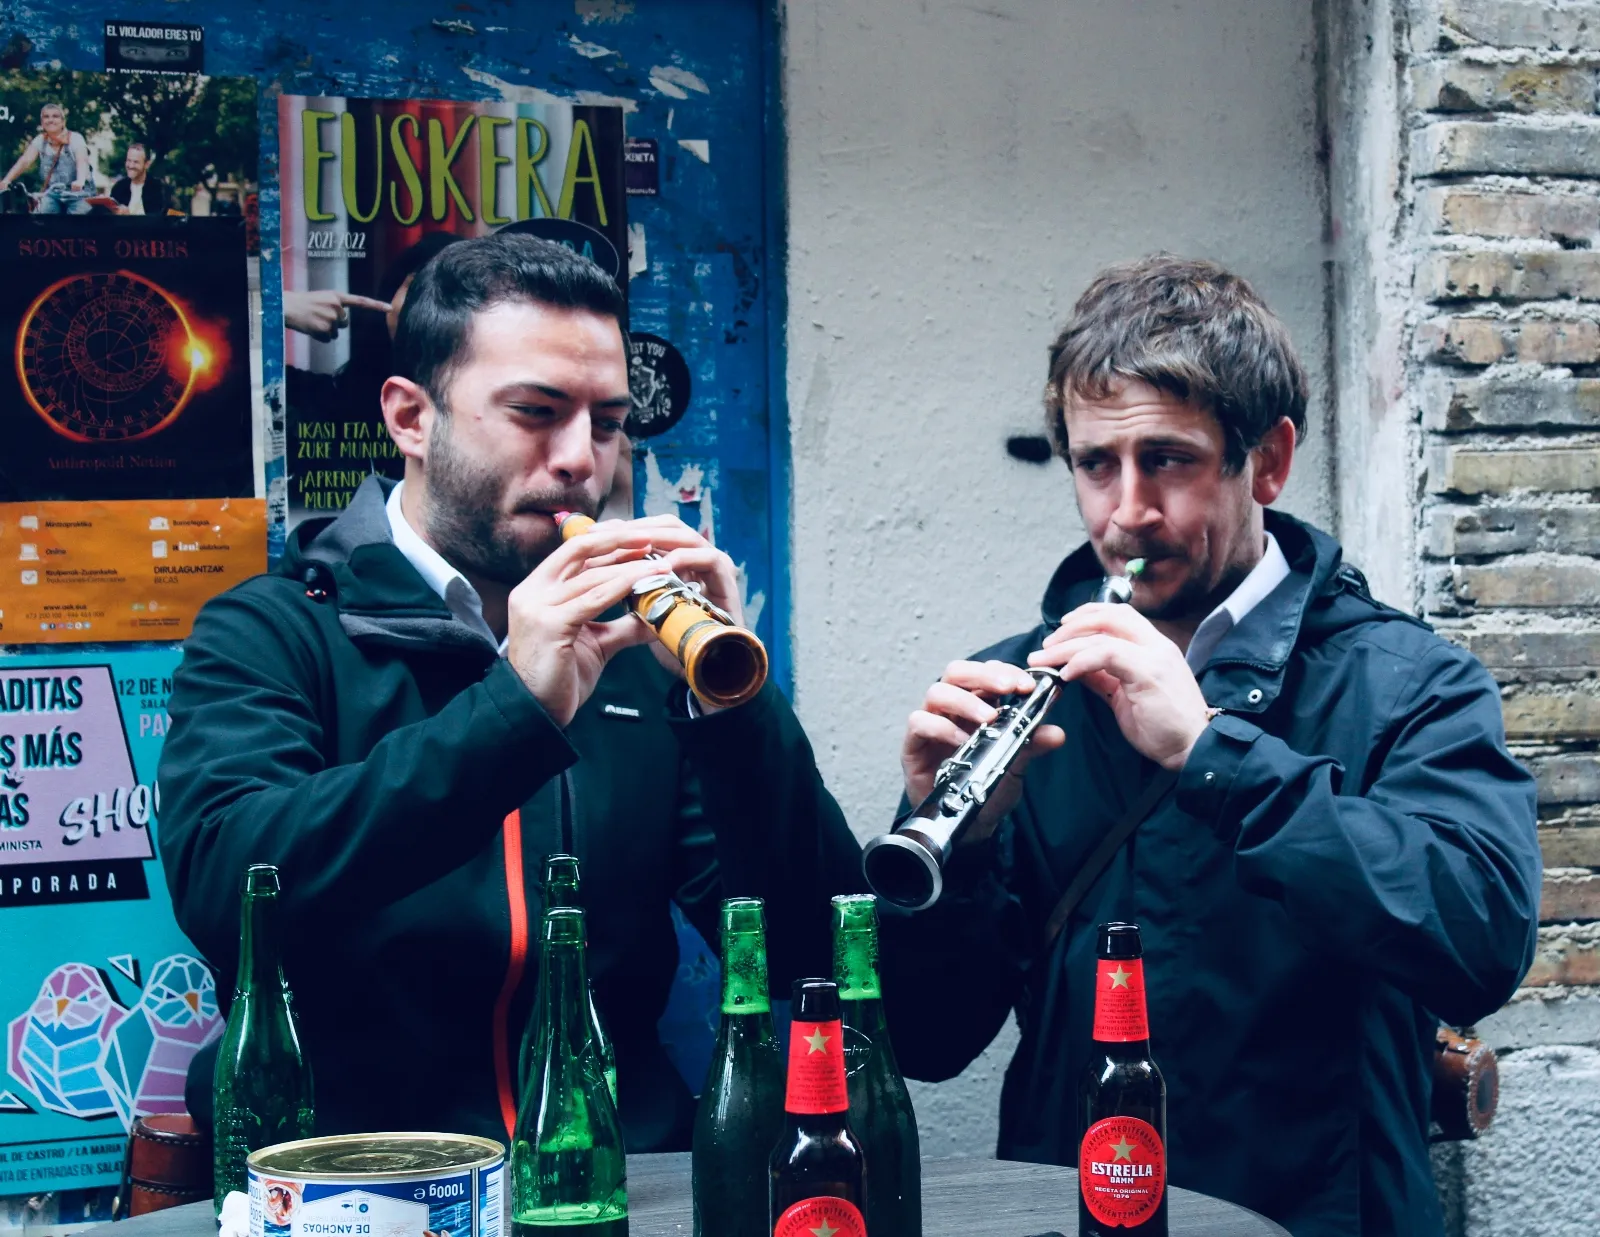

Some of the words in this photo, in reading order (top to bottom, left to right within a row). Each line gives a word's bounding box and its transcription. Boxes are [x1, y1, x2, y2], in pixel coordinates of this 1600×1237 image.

[106, 25, 118, 37] EL
[119, 26, 164, 39] VIOLADOR
[164, 28, 188, 41] ERES
[189, 28, 201, 42] TÚ
[301, 108, 608, 227] EUSKERA
[18, 238, 98, 258] SONUS
[114, 239, 189, 259] ORBIS
[646, 342, 667, 358] YOU
[298, 422, 336, 439] IKASI
[343, 422, 370, 439] ETA
[377, 422, 389, 439] M
[298, 441, 331, 459] ZURE
[154, 565, 224, 574] DIRULAGUNTZAK
[118, 679, 136, 696] 12
[139, 678, 159, 695] DE
[141, 699, 167, 709] SALA
[22, 724, 83, 769] MÁS
[59, 780, 160, 846] SHO
[11, 1151, 24, 1162] DE
[26, 1148, 65, 1161] CASTRO
[75, 1146, 88, 1156] LA
[16, 1168, 28, 1181] DE
[30, 1164, 78, 1180] ENTRADAS
[1091, 1161, 1153, 1177] ESTRELLA
[429, 1182, 465, 1199] 1000g
[1094, 1186, 1118, 1194] RECETA
[302, 1222, 352, 1234] ANCHOAS
[355, 1224, 370, 1234] DE
